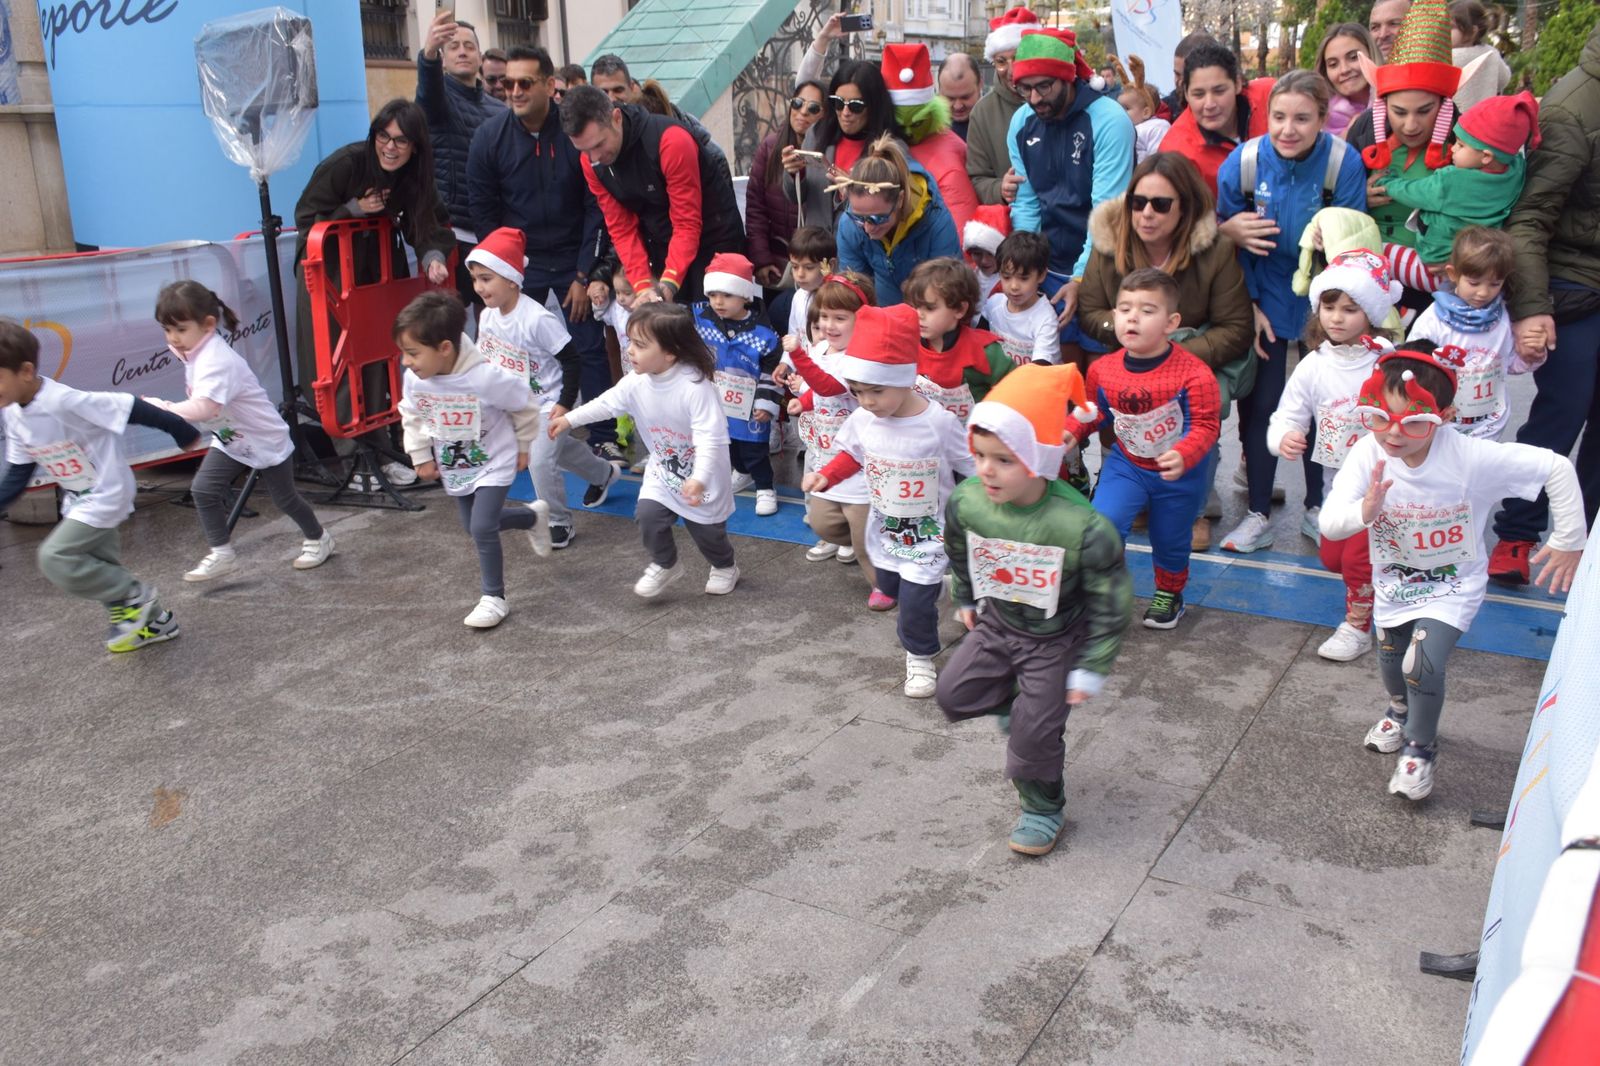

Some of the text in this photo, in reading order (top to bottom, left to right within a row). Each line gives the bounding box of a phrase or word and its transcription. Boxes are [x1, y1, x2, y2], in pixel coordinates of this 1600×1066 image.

[38, 0, 179, 71] eporte
[216, 310, 273, 349] eporte
[500, 354, 525, 373] 293
[724, 390, 744, 405] 85
[1473, 381, 1494, 400] 11
[441, 411, 474, 426] 127
[1144, 416, 1177, 443] 498
[47, 458, 83, 477] 123
[899, 480, 925, 499] 32
[1412, 525, 1464, 550] 108
[1392, 584, 1434, 601] Mateo
